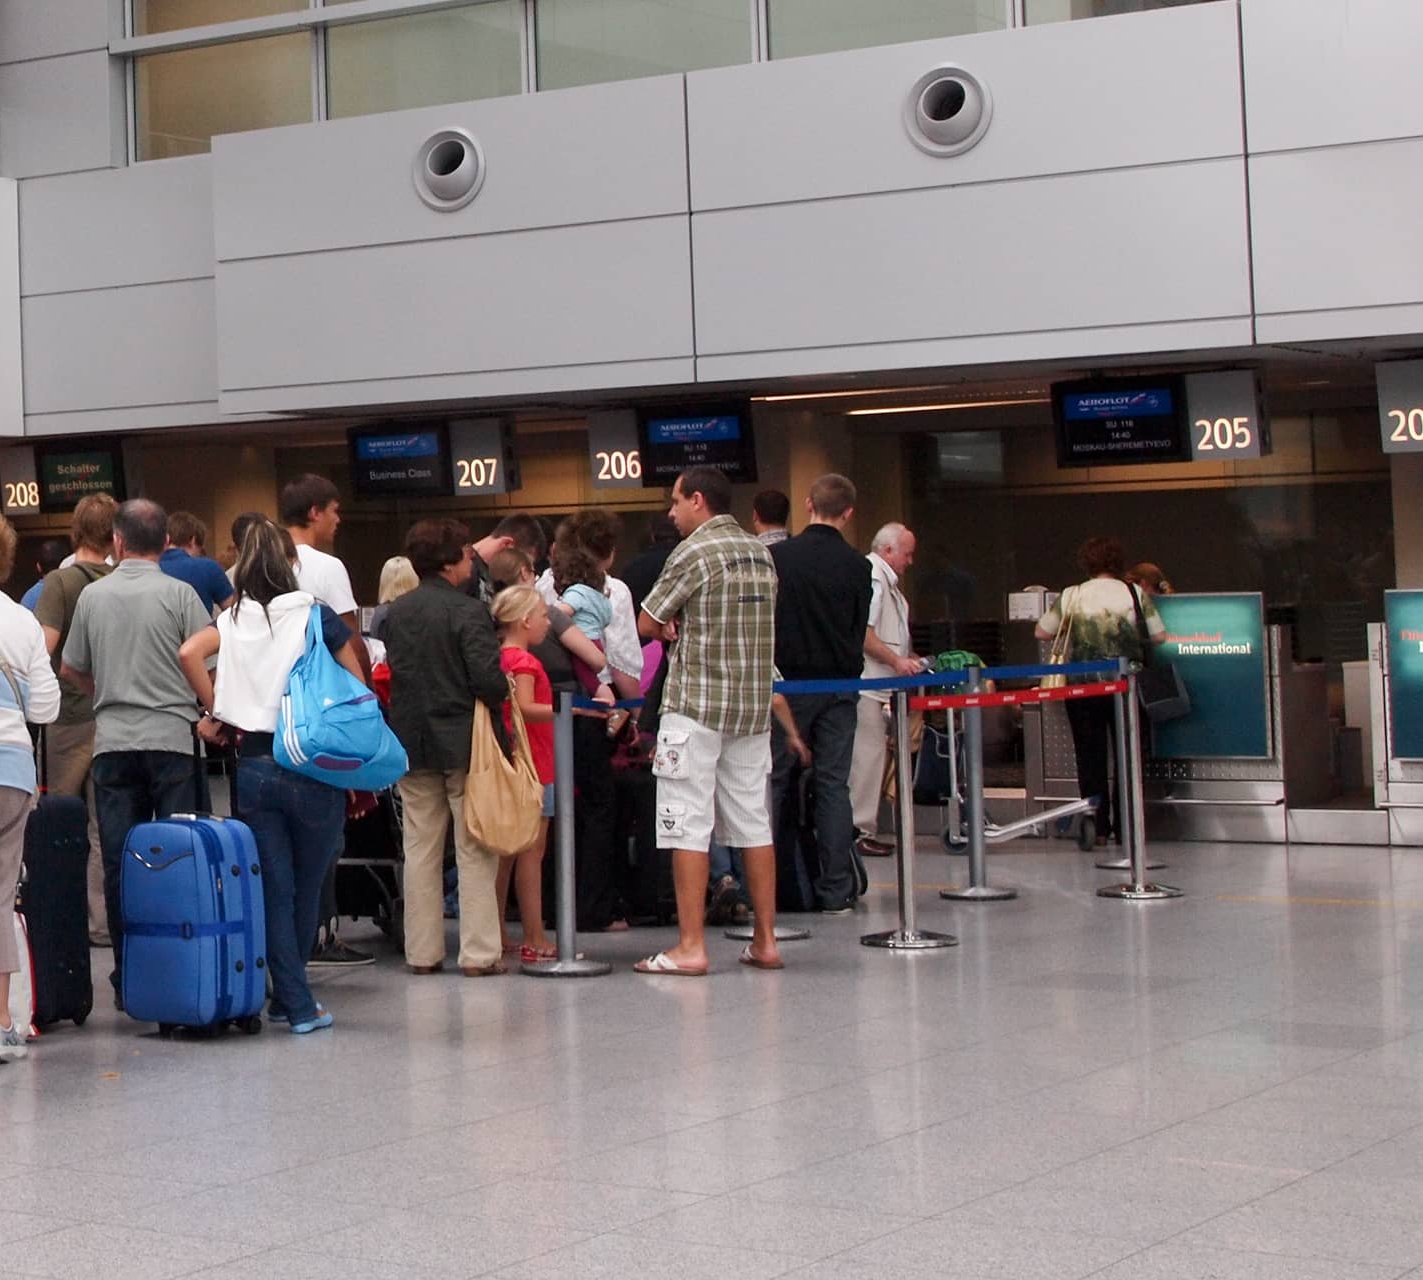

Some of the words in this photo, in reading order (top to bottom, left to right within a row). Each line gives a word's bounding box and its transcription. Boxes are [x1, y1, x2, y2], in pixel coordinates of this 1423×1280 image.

[1194, 416, 1252, 451] 205
[57, 463, 101, 475] Schalter
[369, 470, 407, 481] Business
[456, 458, 498, 488] 207
[595, 450, 642, 480] 206
[4, 481, 40, 508] 208
[48, 480, 114, 494] geschlossen
[1177, 641, 1252, 656] International
